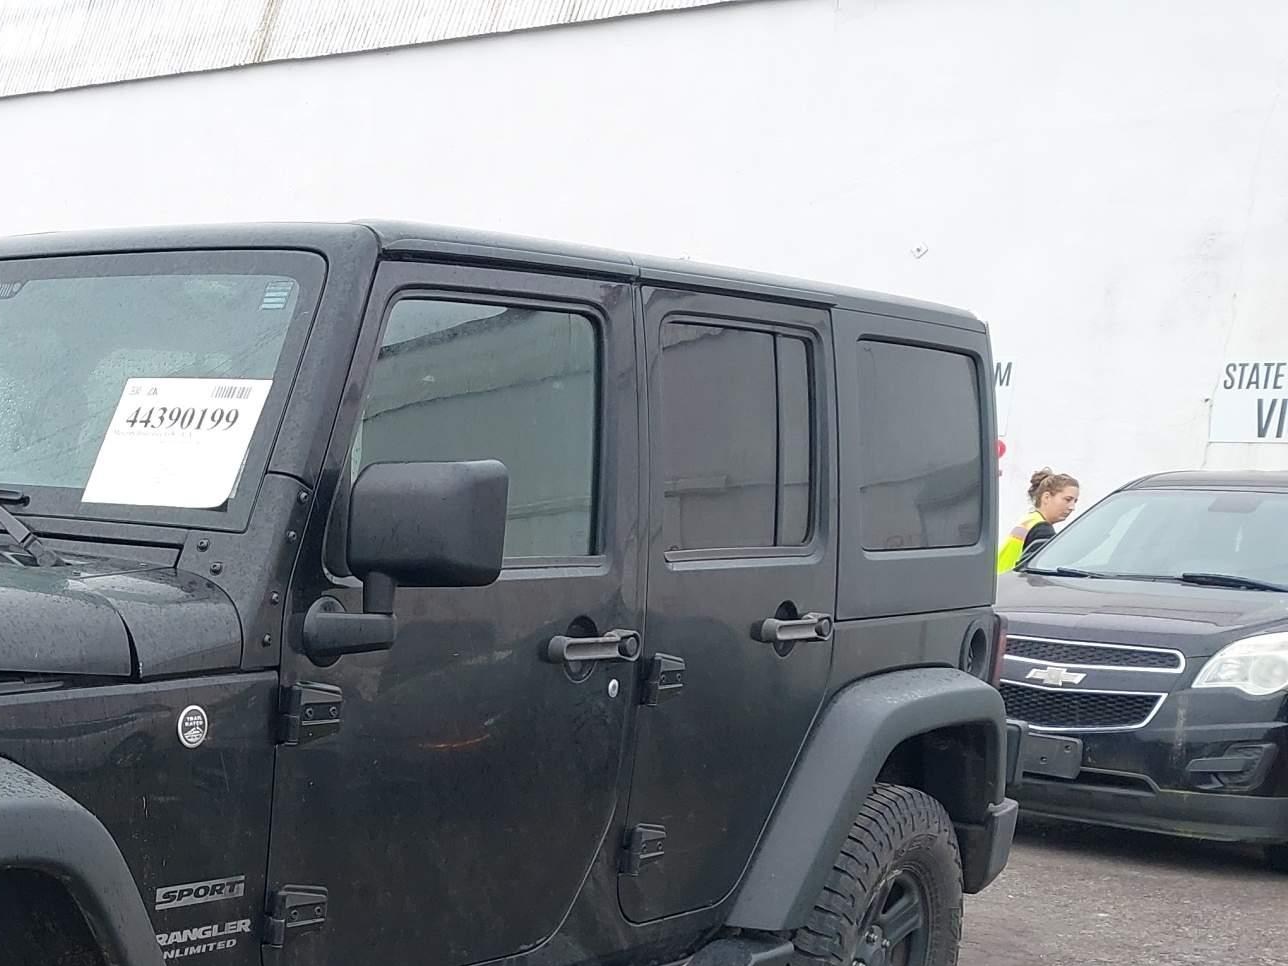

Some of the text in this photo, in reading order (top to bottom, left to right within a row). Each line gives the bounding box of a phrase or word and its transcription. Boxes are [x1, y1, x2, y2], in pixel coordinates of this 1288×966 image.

[1223, 362, 1287, 390] STATE
[126, 406, 239, 431] 44390199
[155, 880, 244, 906] SPORT
[156, 919, 251, 946] RANGLER
[163, 939, 237, 960] NLIMITED
